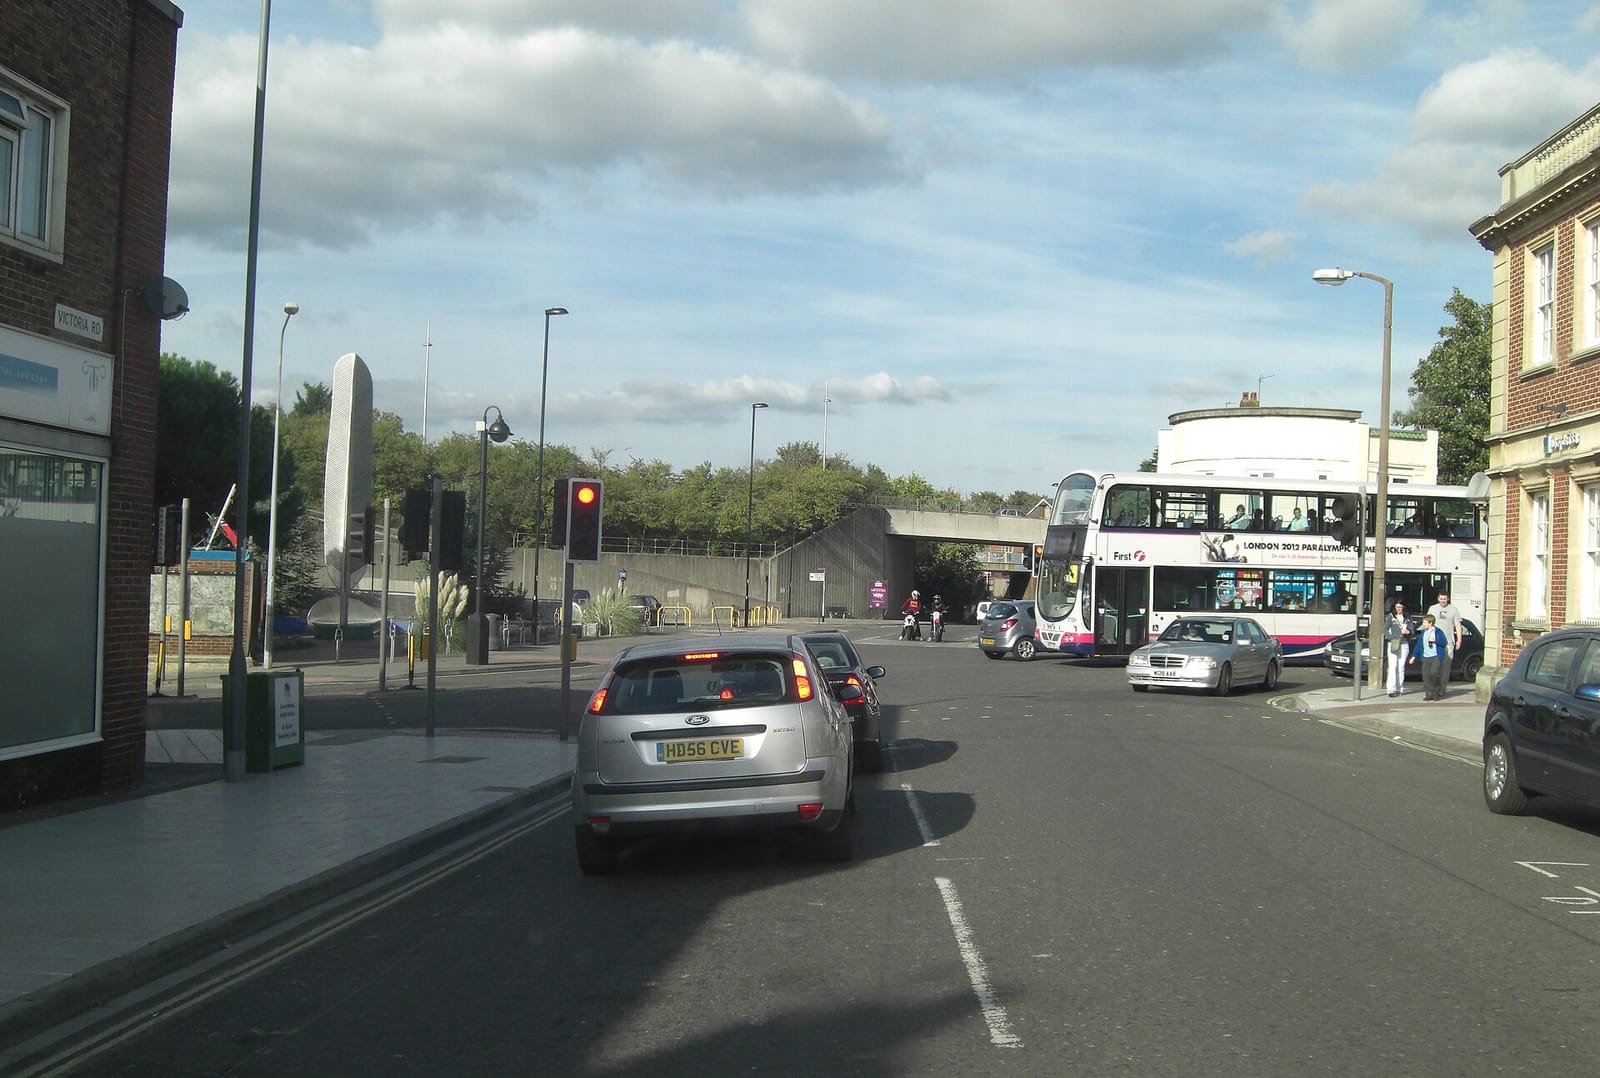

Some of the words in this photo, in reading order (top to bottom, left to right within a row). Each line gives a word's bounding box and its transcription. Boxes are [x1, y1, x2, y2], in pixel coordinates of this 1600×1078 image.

[57, 309, 90, 333] VICTORIA
[91, 320, 102, 336] RD
[1243, 541, 1279, 550] LONDON
[1281, 543, 1300, 551] 2012
[1301, 544, 1350, 553] PARALYMPIC
[1352, 545, 1376, 553] GME
[1113, 551, 1131, 561] First
[665, 742, 706, 758] HD56
[710, 739, 740, 756] CVE
